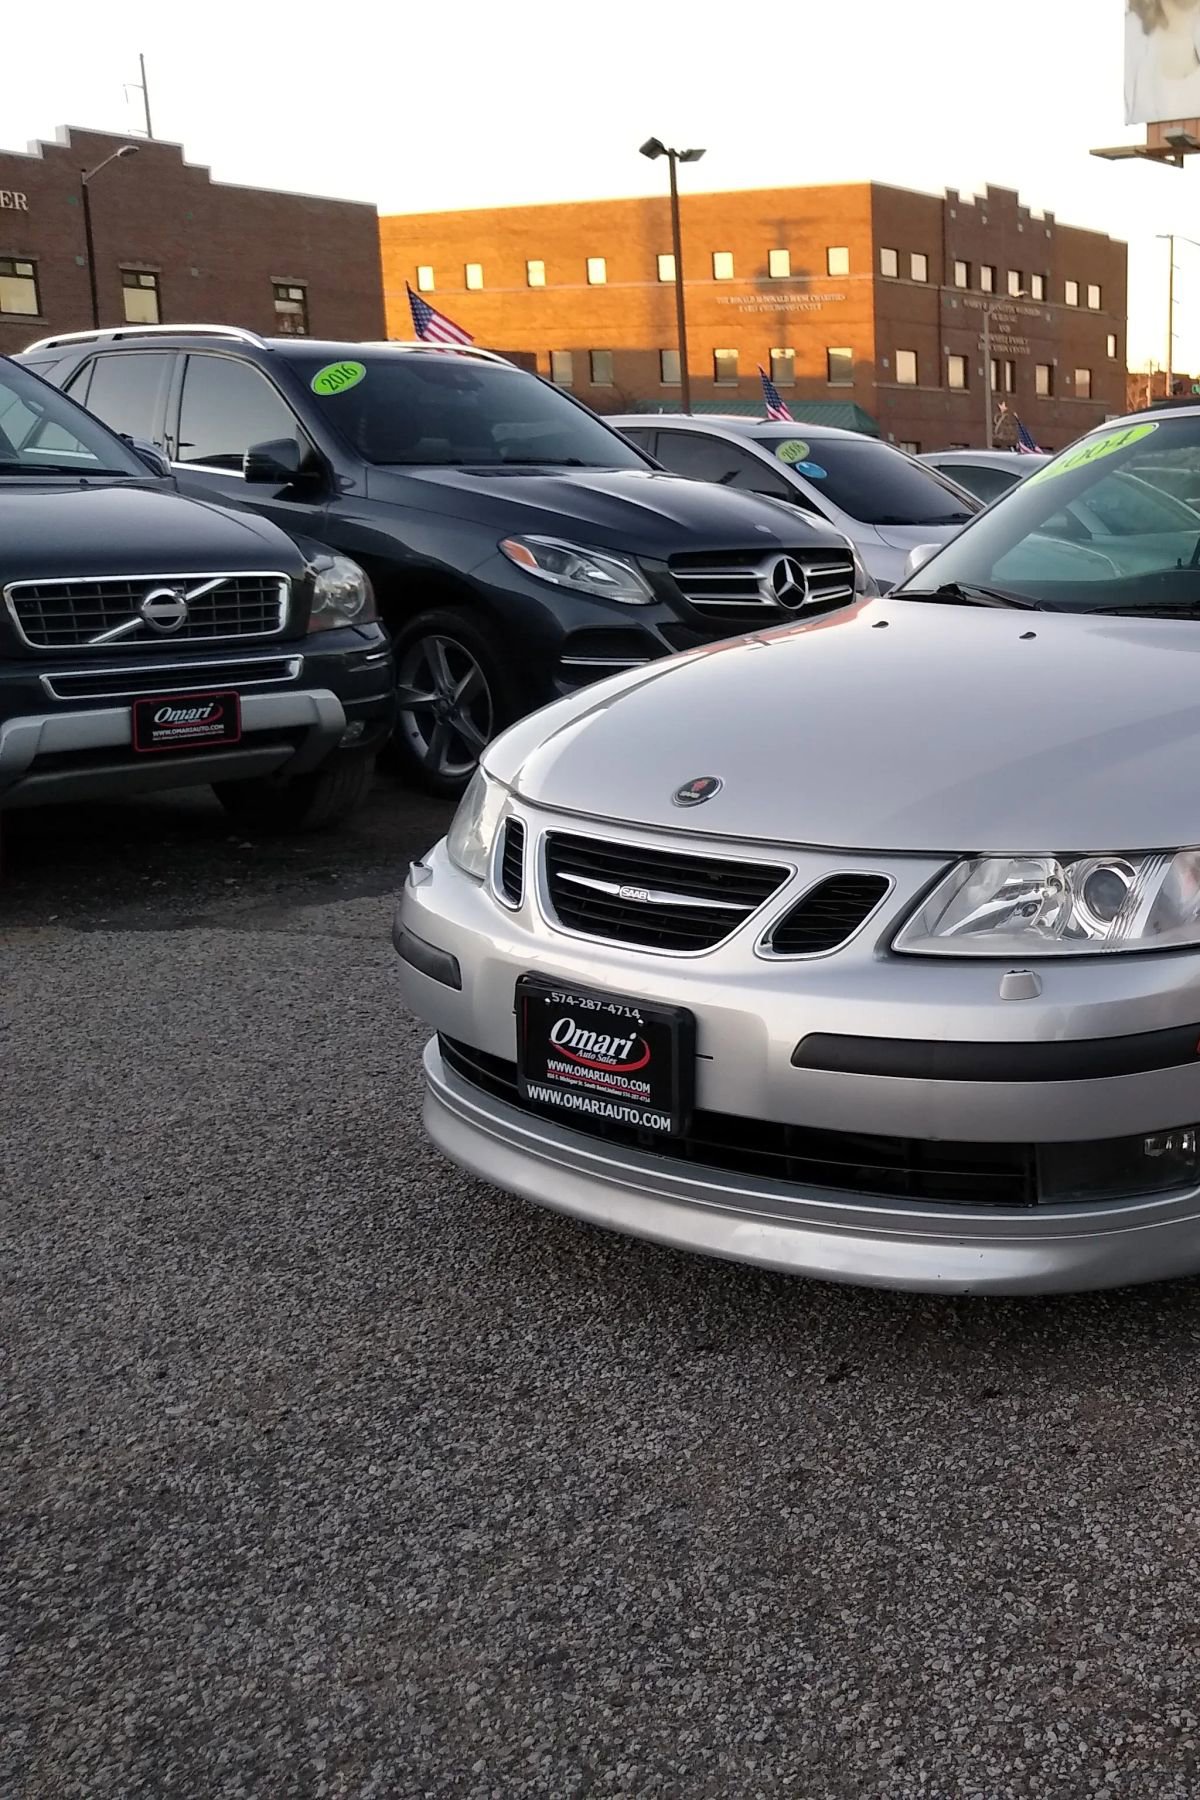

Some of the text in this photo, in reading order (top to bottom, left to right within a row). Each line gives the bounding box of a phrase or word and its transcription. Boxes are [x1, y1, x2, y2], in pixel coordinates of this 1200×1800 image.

[0, 190, 29, 211] ER
[321, 365, 358, 391] 2016
[154, 702, 214, 723] Omari
[622, 887, 648, 900] SAAB
[551, 992, 641, 1019] 574-287-4714
[550, 1017, 637, 1060] Omari
[576, 1049, 618, 1066] Auto Sales
[547, 1059, 651, 1094] WWW.OMARIAUTO.COM
[527, 1085, 671, 1131] WWW.OMARIAUTO.COM
